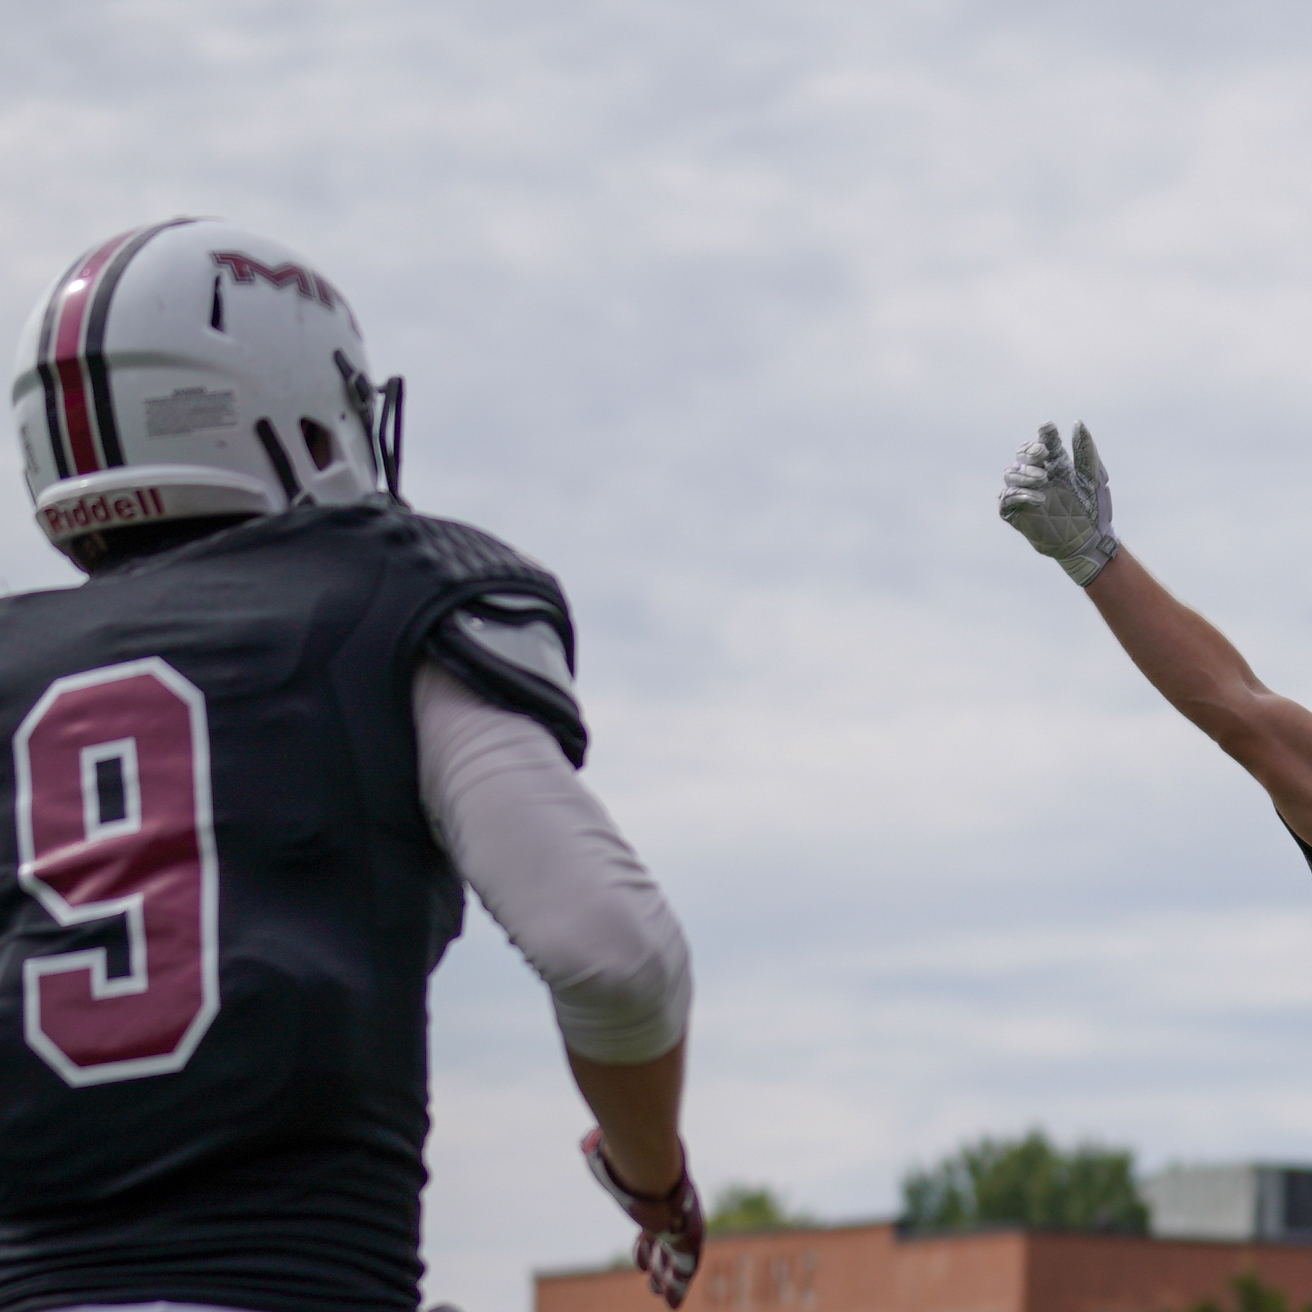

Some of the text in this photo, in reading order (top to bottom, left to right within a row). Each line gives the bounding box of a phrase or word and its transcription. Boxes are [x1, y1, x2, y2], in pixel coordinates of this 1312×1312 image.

[210, 251, 354, 332] MI
[43, 486, 165, 535] Riddell
[11, 655, 221, 1090] 9
